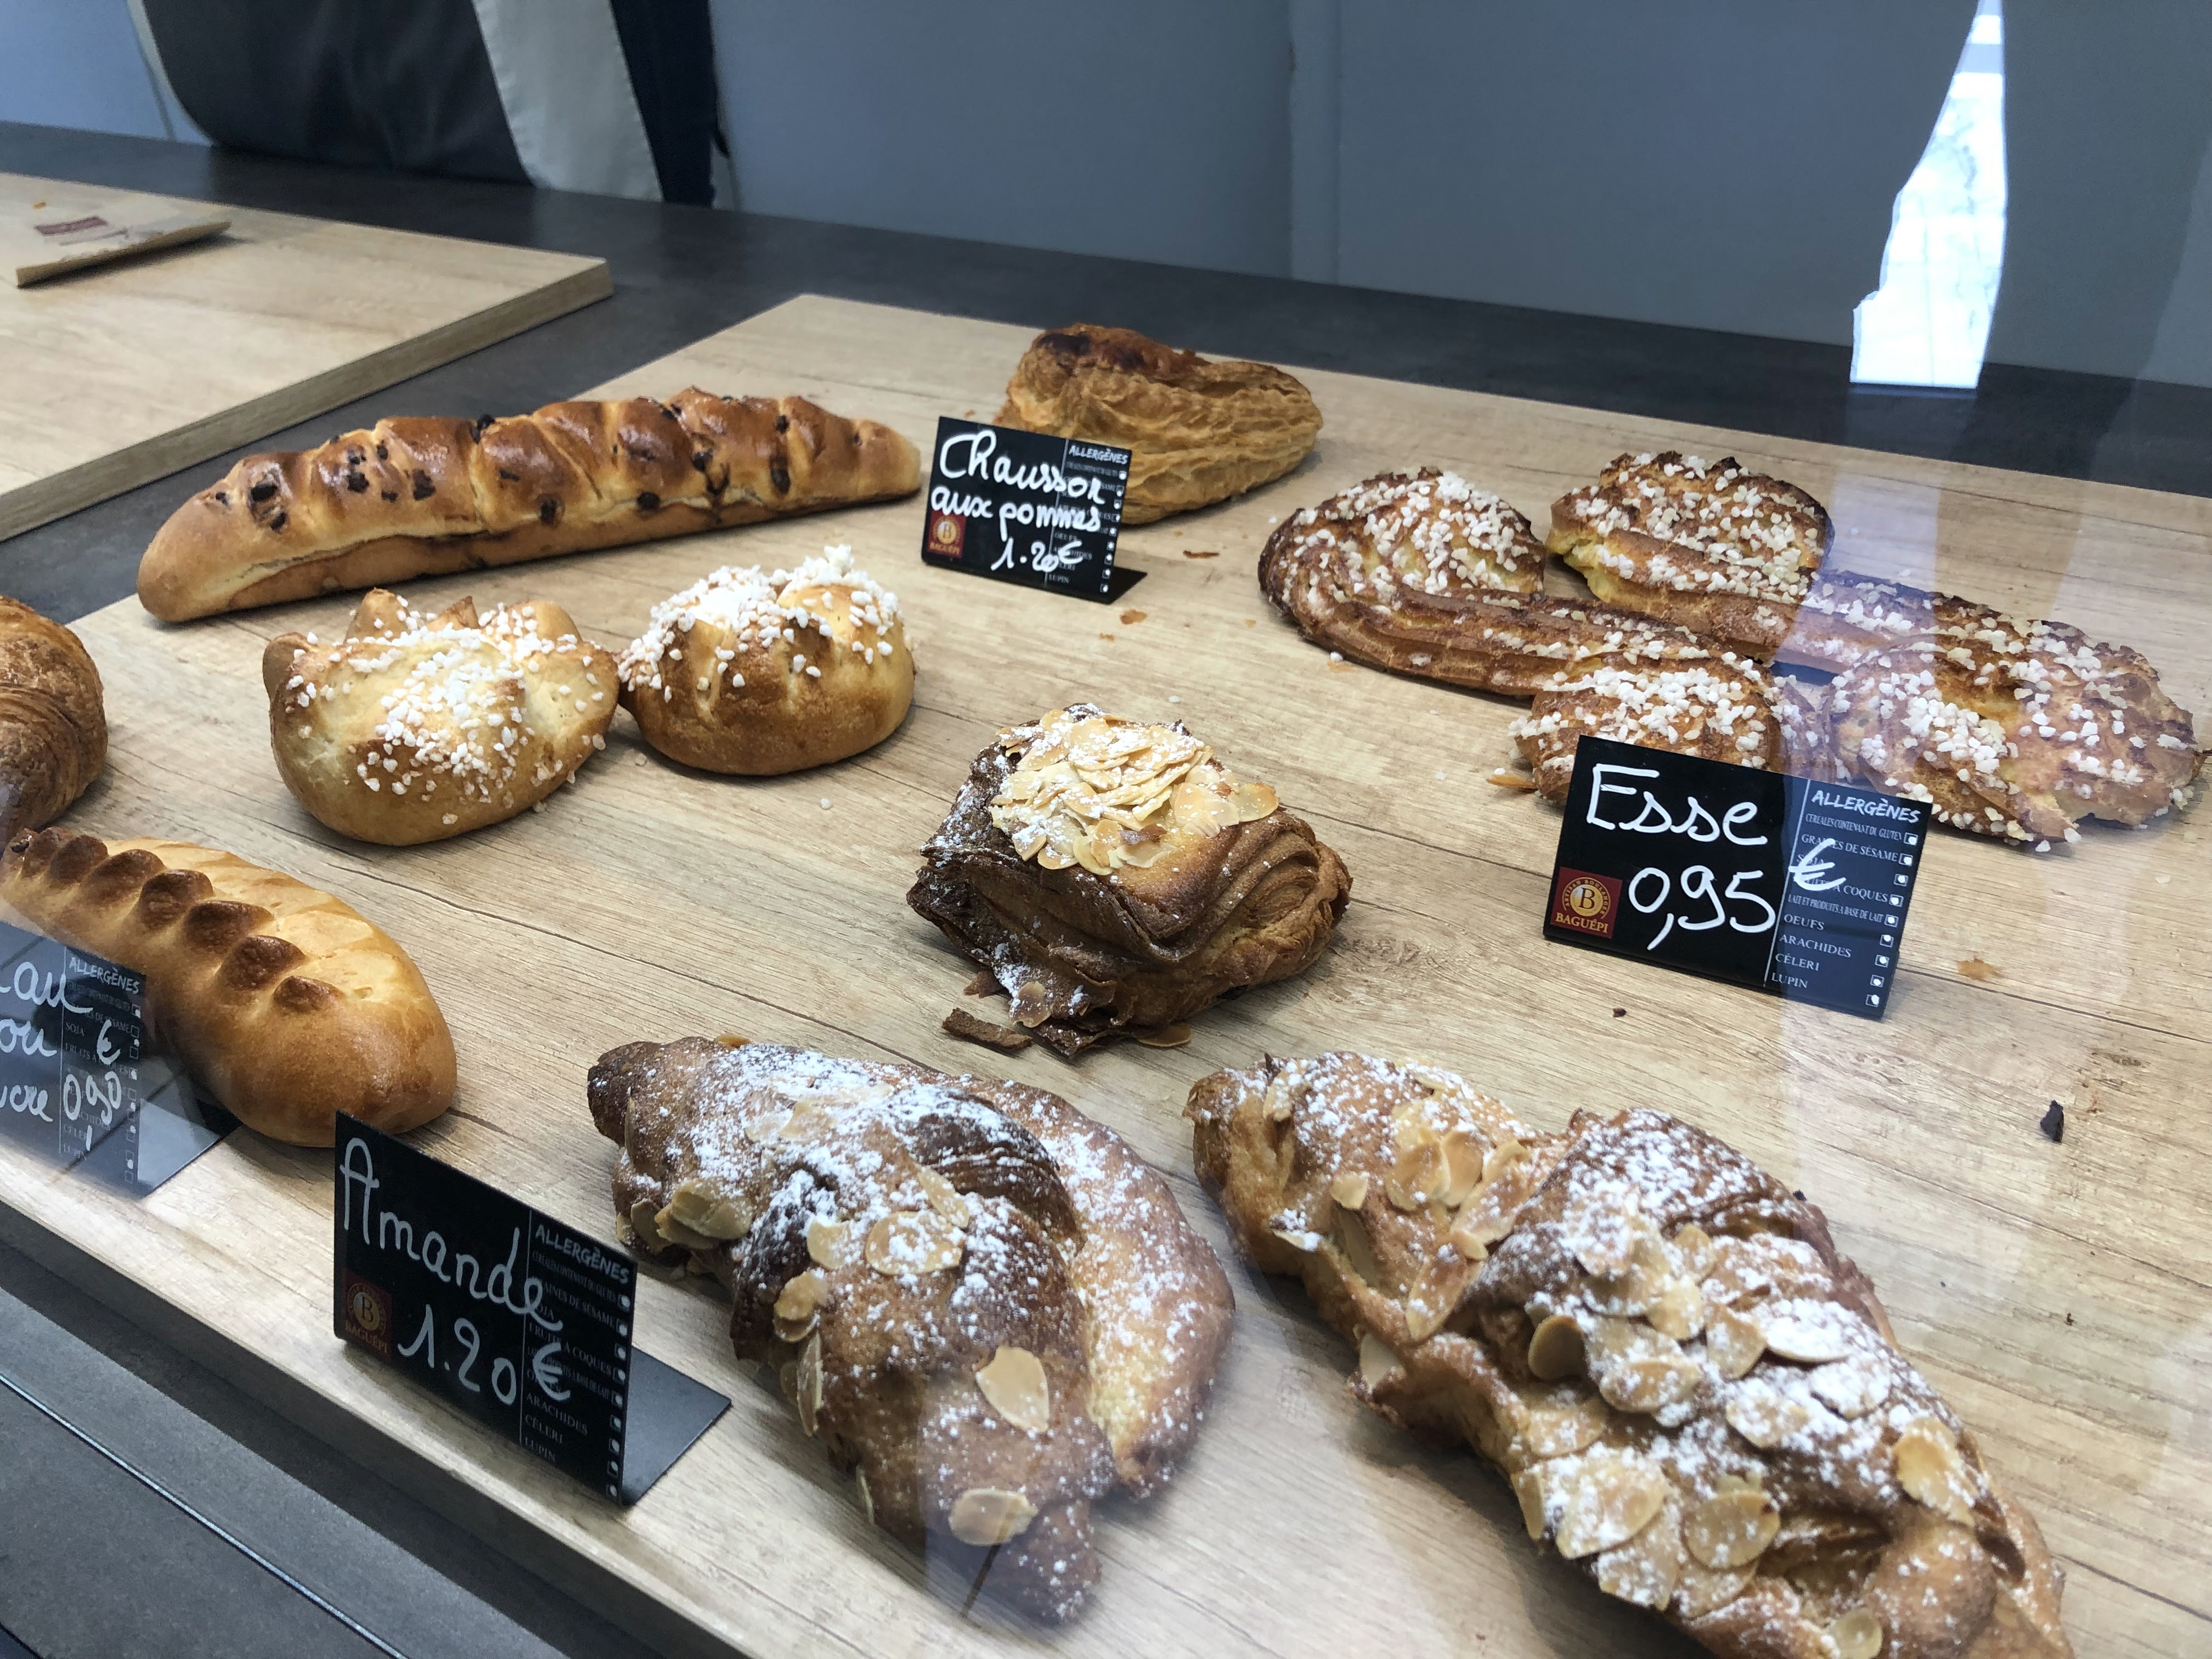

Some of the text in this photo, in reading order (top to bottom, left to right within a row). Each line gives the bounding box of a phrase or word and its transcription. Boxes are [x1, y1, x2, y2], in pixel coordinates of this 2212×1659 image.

[1068, 444, 1128, 465] ALLERGÈNES
[940, 430, 1105, 504] Chausson
[931, 486, 994, 518] aux
[999, 501, 1101, 542] pommes
[1586, 763, 1768, 845] Esse
[1810, 788, 1921, 825] ALLERGÈNES
[1844, 842, 1860, 854] DE
[1577, 887, 1595, 910] B
[1842, 884, 1889, 904] COQUES
[1783, 913, 1825, 931] OEUFS
[1859, 910, 1868, 919] DE
[1868, 912, 1883, 923] LAIT
[1779, 932, 1852, 958] ARACHIDES
[1774, 951, 1820, 972] CÉLERI
[69, 955, 140, 995] ALLERGÈNES
[1771, 972, 1808, 990] LUPIN
[66, 1021, 84, 1036] SOJA
[340, 1137, 563, 1331] Amande
[535, 1221, 629, 1287] ALLERGÈNES
